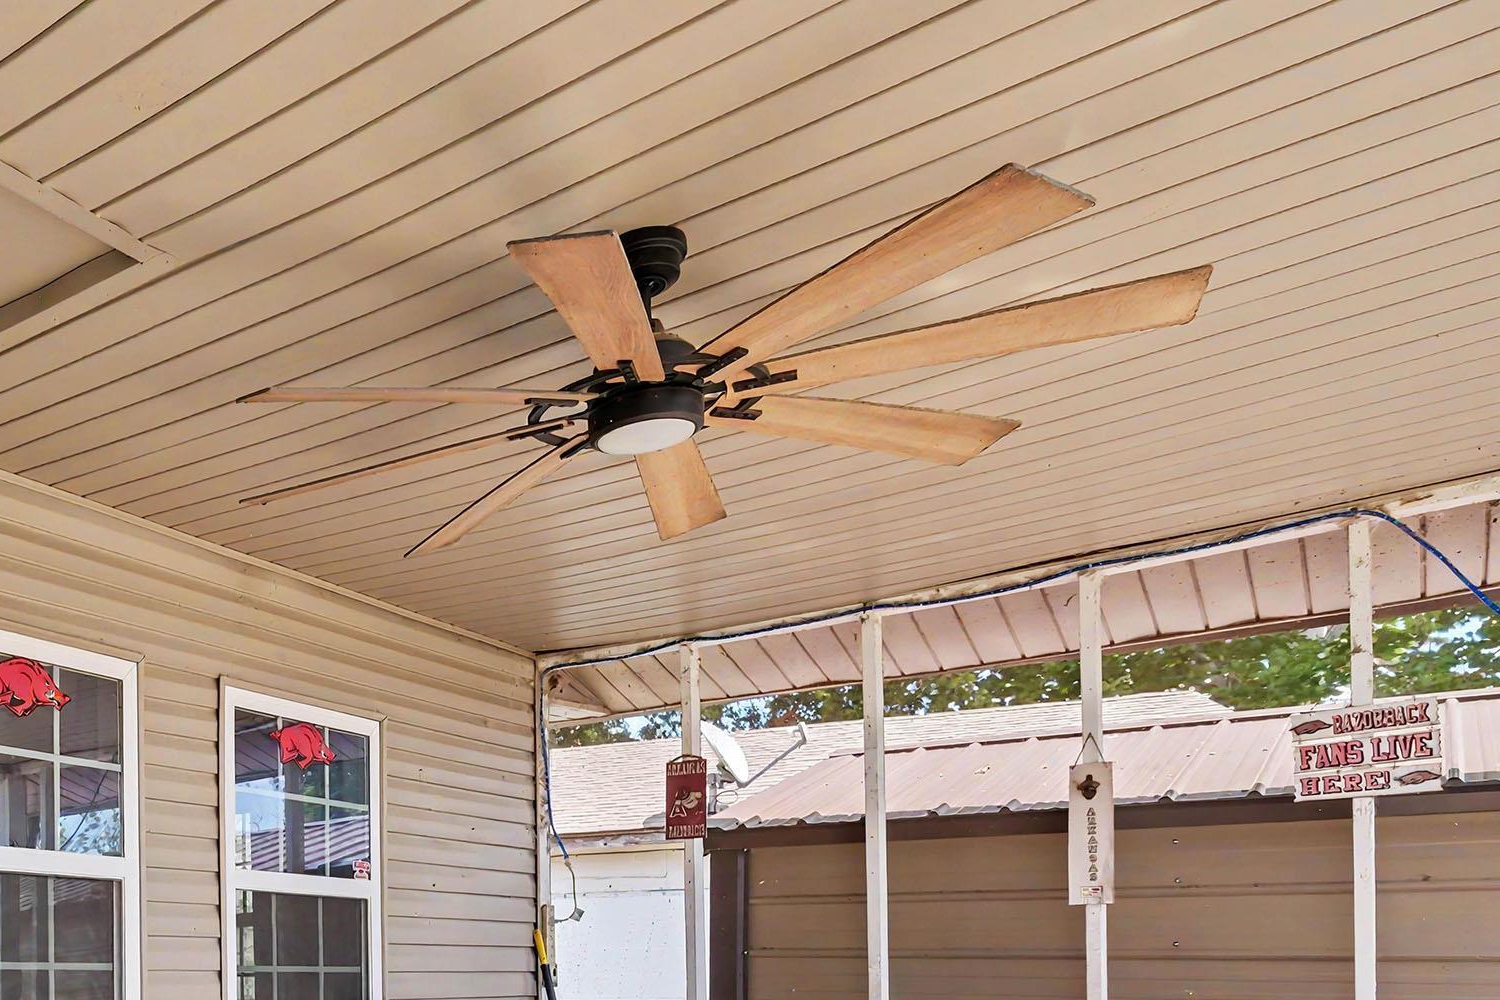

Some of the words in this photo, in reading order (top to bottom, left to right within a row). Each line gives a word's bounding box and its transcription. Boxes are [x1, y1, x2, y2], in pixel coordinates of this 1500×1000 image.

[1300, 739, 1365, 771] FANS
[1369, 731, 1434, 763] LIVE
[1300, 770, 1392, 797] HERE!
